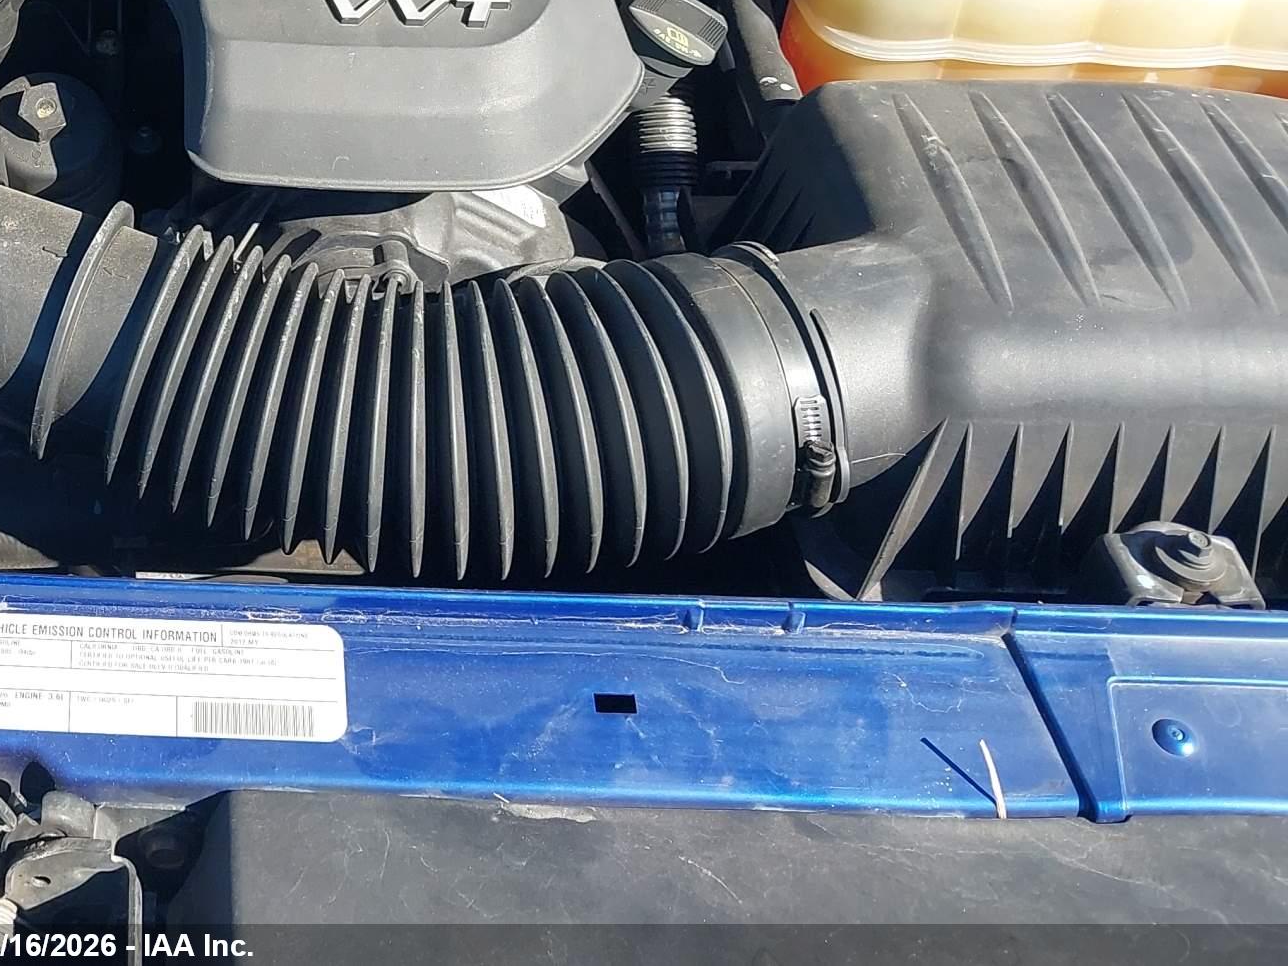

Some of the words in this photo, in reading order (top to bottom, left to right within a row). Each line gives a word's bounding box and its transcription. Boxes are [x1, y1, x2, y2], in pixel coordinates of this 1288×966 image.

[32, 625, 84, 637] EMISSION
[88, 626, 137, 640] CONTROL
[142, 629, 217, 642] INFORMATION
